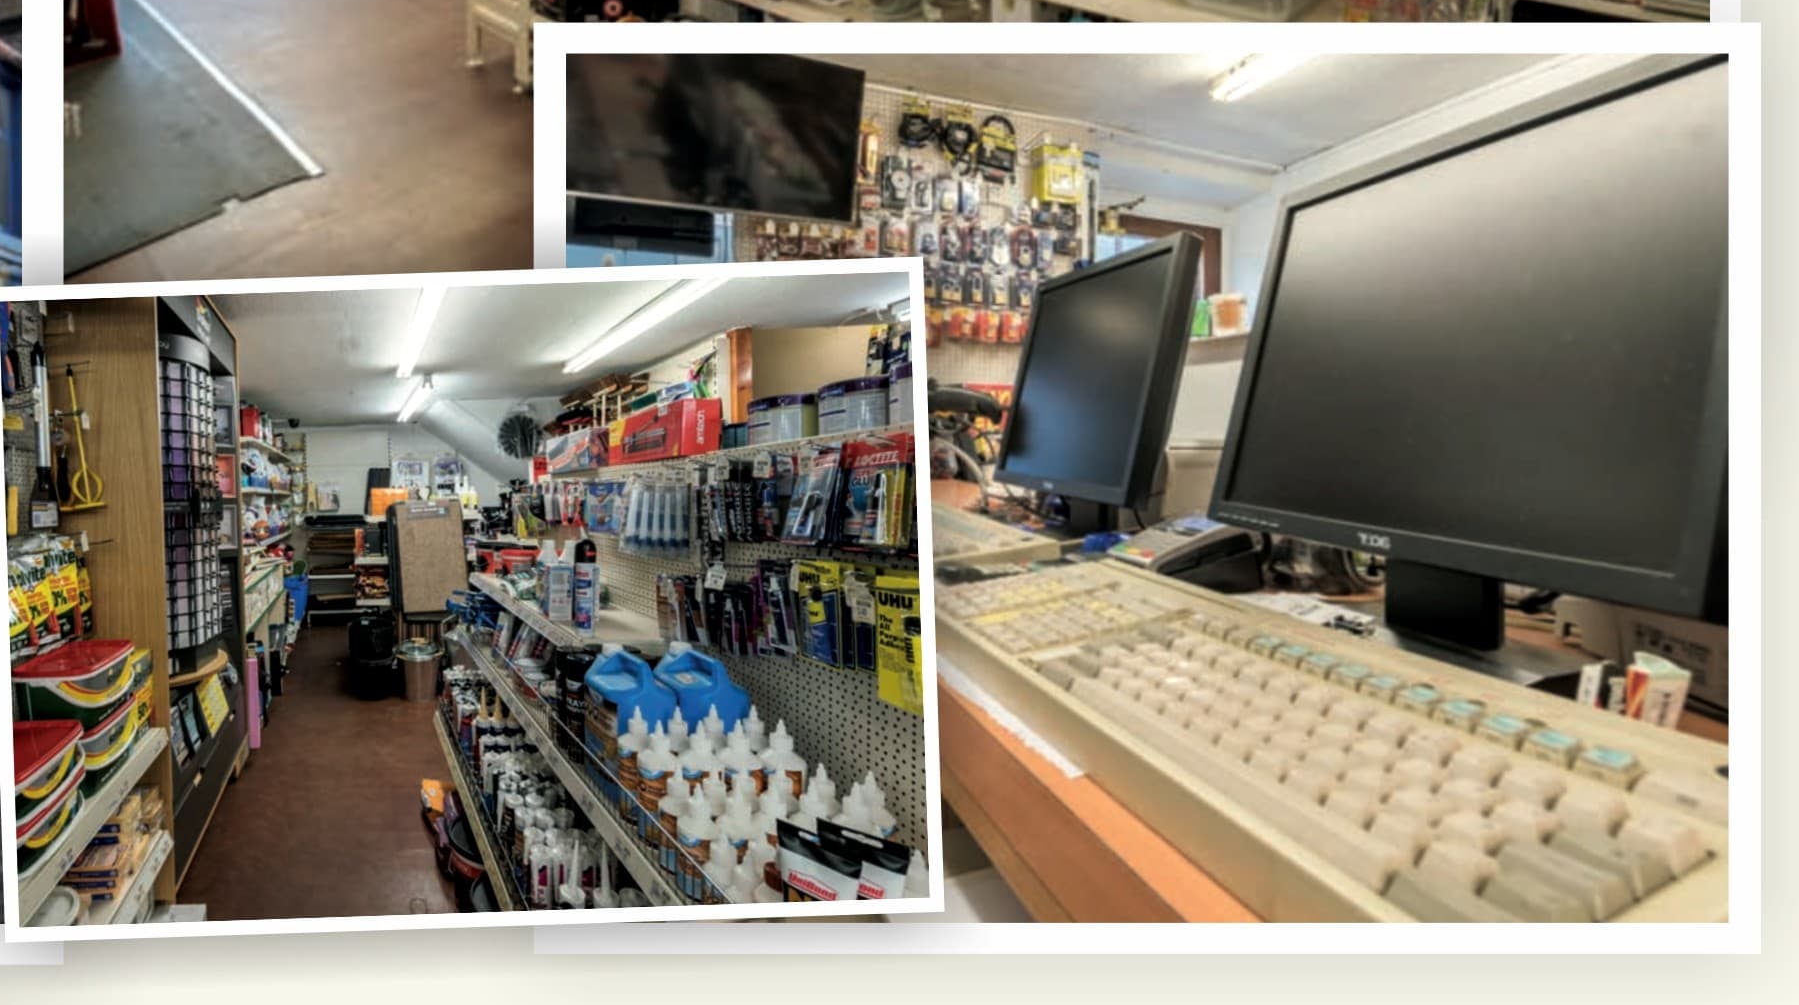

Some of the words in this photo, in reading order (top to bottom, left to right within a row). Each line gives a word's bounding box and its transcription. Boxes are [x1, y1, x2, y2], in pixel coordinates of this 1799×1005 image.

[853, 451, 899, 469] LOCTITE
[799, 571, 820, 584] UHU
[879, 592, 914, 610] UHU
[789, 873, 838, 902] UniBond
